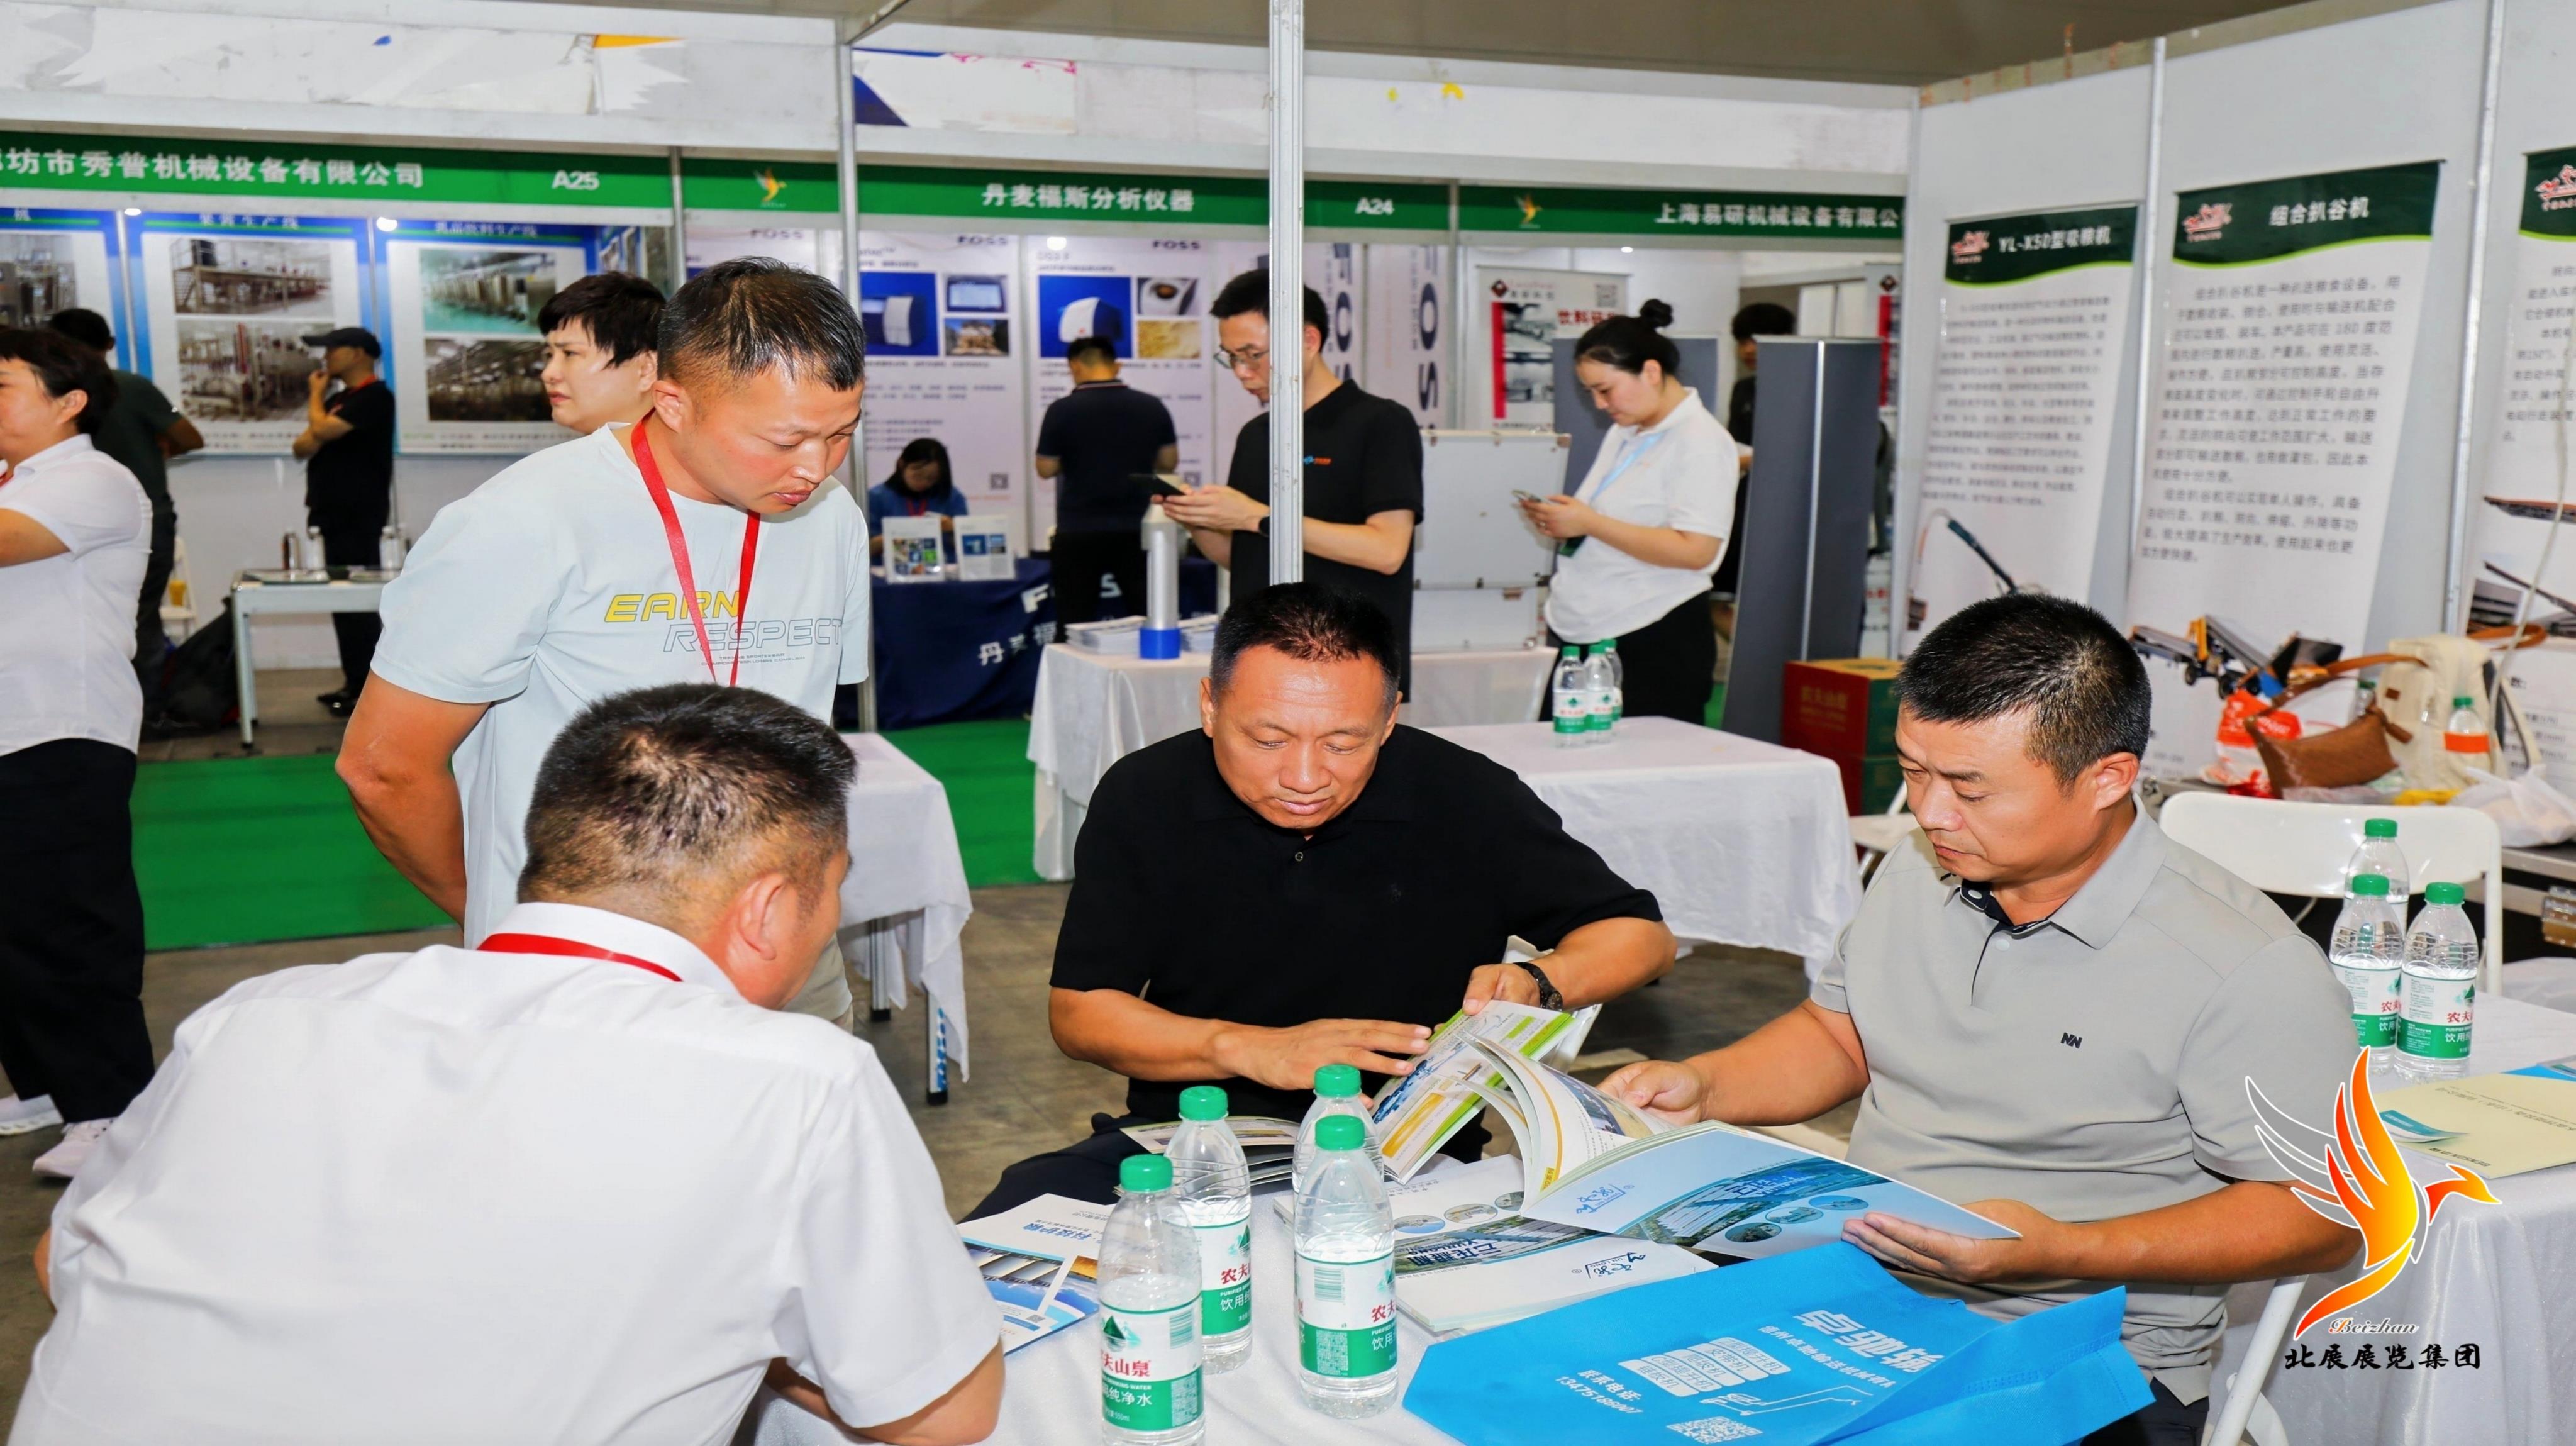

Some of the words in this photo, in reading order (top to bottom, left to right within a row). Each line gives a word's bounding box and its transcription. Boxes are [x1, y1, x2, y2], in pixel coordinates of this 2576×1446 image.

[0, 147, 423, 188] 坊市秀普机械设备有限公司
[552, 170, 600, 190] A25
[982, 184, 1194, 212] 丹麦福斯分析仪器
[1355, 197, 1394, 215] A24
[1655, 202, 1905, 228] 上海易研机械设备有限公
[2268, 196, 2369, 226] 组合扒谷机
[1153, 240, 1201, 250] FOSS
[604, 590, 741, 623] EARN
[663, 618, 842, 653] RESPECT
[2446, 1010, 2474, 1023] 农夫
[1220, 1263, 1251, 1285] 农夫
[1371, 1331, 1396, 1351] 饮用
[1709, 1347, 1751, 1372] 皮带机
[1650, 1356, 1717, 1390] C型提升机
